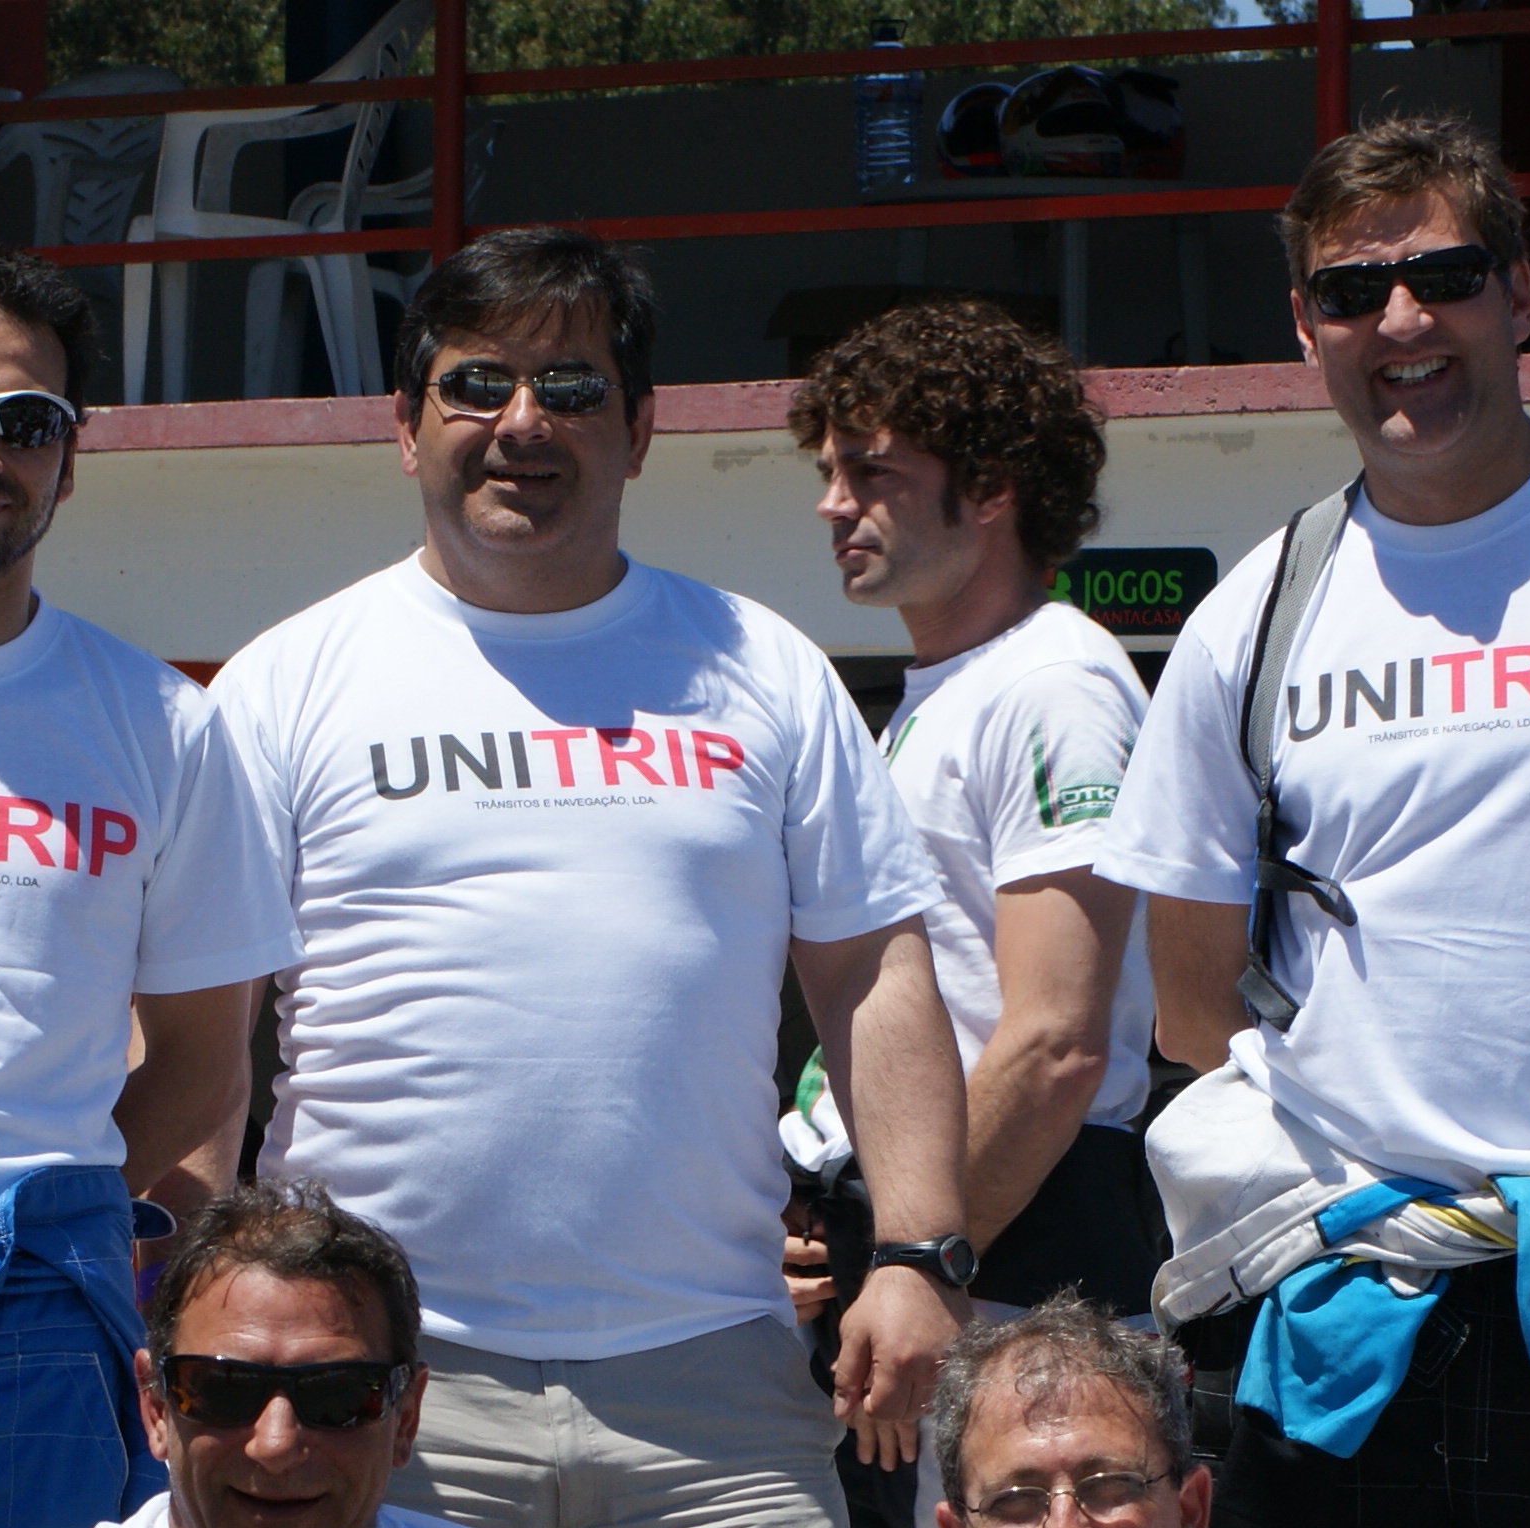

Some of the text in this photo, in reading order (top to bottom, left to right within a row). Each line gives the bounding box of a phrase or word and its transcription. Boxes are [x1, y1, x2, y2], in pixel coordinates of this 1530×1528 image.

[1083, 569, 1184, 614] JOGOS
[1367, 727, 1430, 744] TRÂNSITOS
[1430, 727, 1439, 736] E
[369, 727, 745, 801] UNITRIP
[473, 795, 658, 811] TRÂNSITOS E NAVEGAÇÃO, LDA.
[1060, 786, 1118, 805] OTK
[16, 876, 41, 888] LDA.
